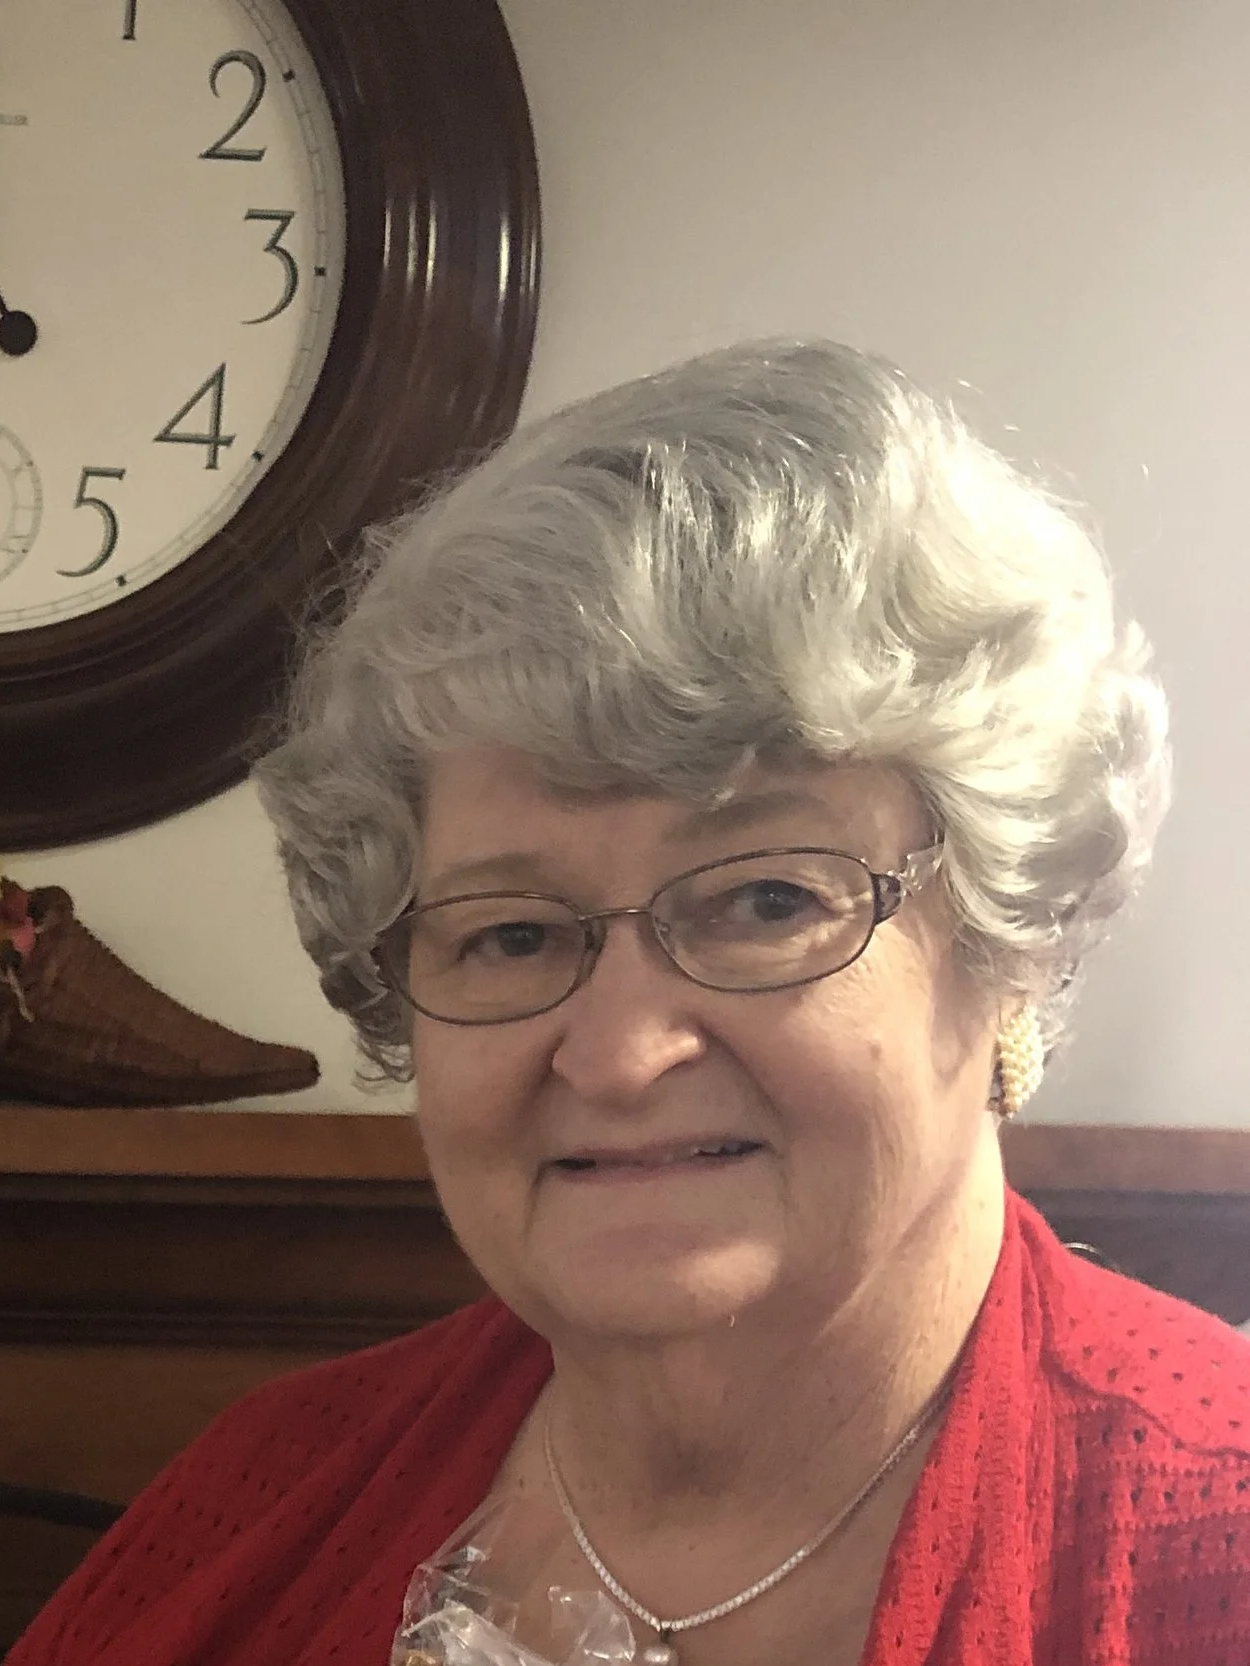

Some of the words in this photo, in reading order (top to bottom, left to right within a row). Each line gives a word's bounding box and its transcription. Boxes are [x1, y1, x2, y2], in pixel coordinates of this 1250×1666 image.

[199, 50, 267, 162] 2
[240, 208, 299, 325] 3
[152, 362, 236, 471] 4
[56, 466, 127, 578] 5
